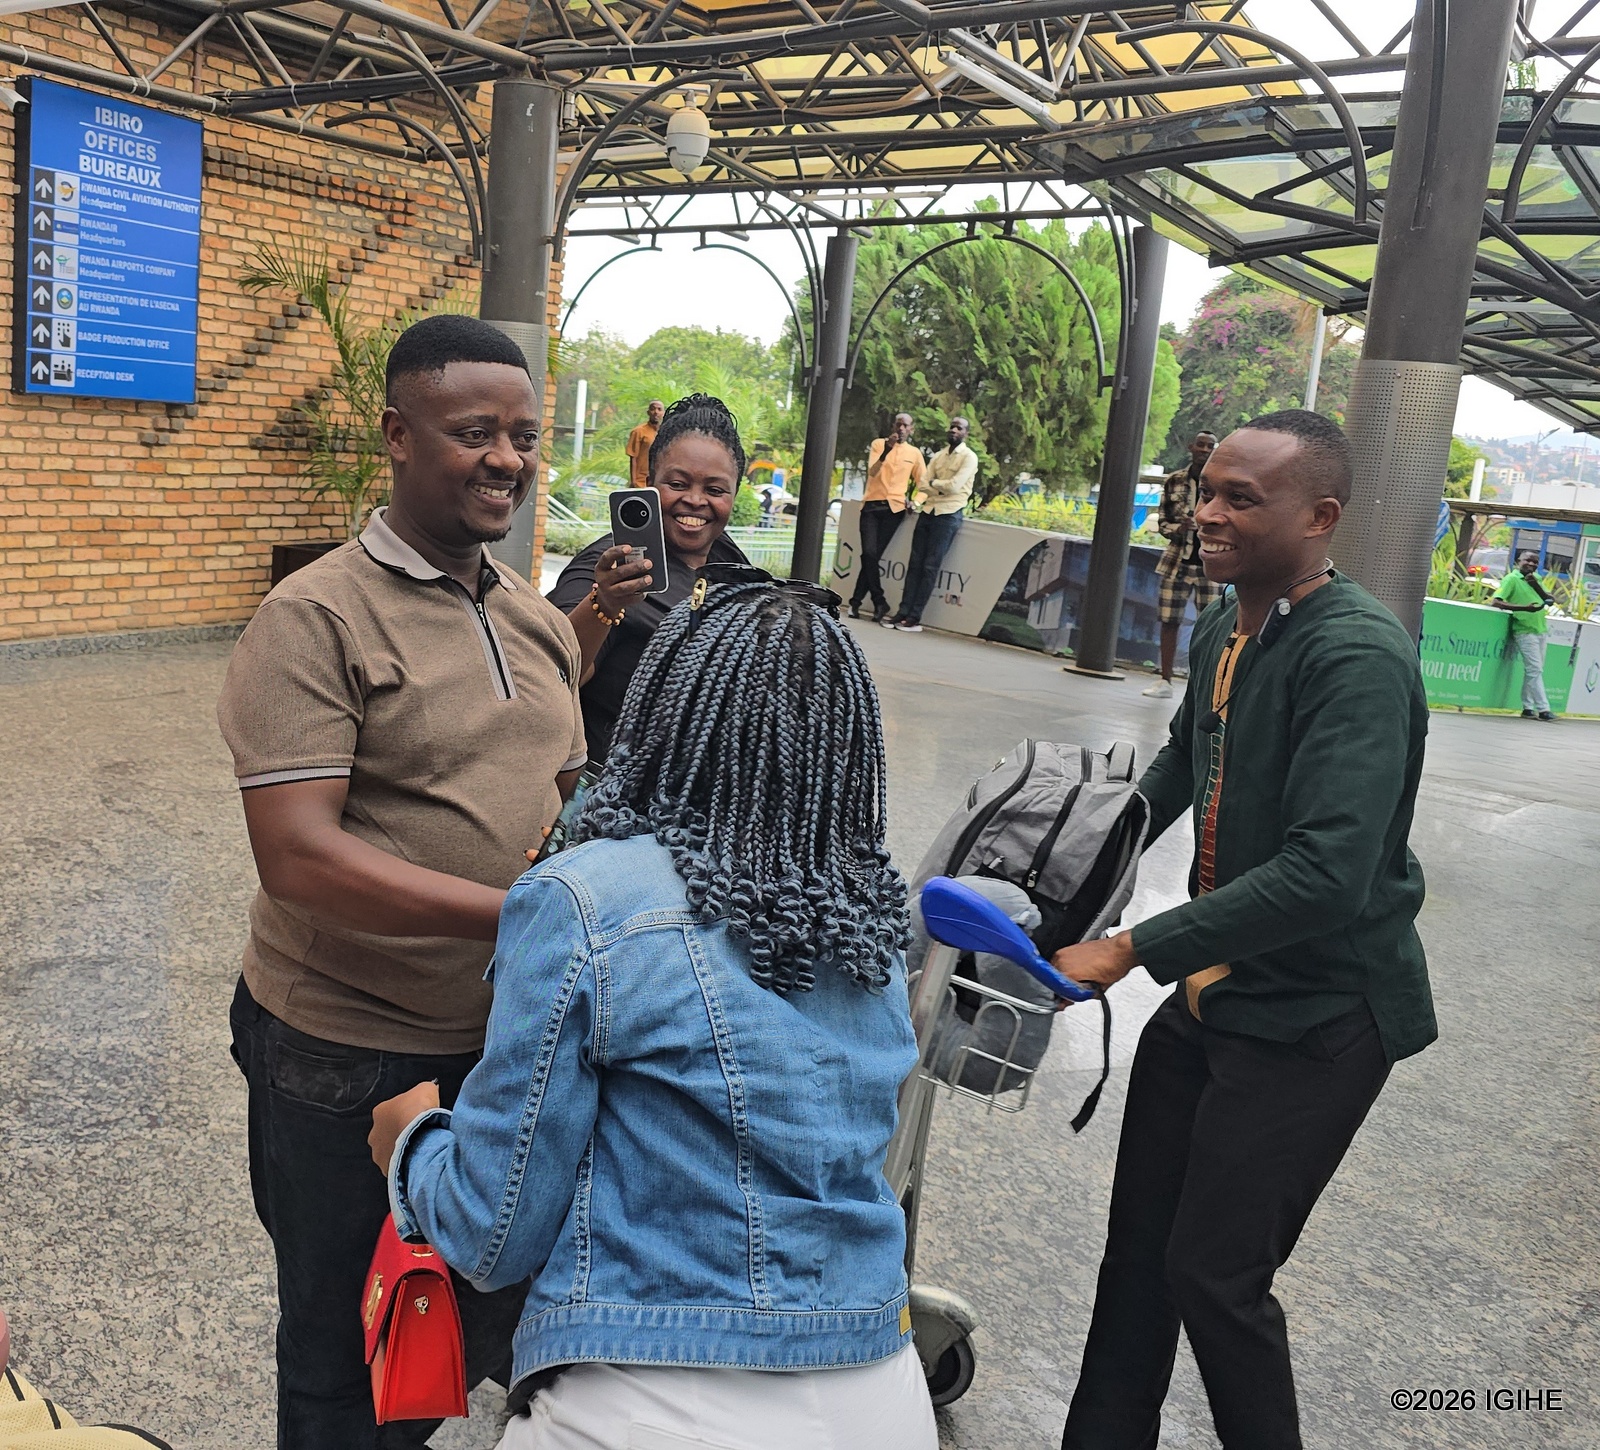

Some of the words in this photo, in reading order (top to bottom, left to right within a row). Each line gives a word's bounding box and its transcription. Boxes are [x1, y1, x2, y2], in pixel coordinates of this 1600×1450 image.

[95, 106, 143, 134] IBIRO
[84, 130, 157, 162] OFFICES
[79, 154, 162, 188] BUREAUX
[81, 182, 112, 197] RWANDA
[112, 189, 131, 201] CIVIL
[131, 193, 163, 207] AVIATION
[163, 200, 199, 215] AUTHORITY
[81, 195, 127, 212] Headquarters
[80, 218, 118, 233] RWANDAIR
[80, 230, 126, 247] Headquarters
[79, 254, 111, 267] RWANDA
[111, 259, 144, 273] AIRPORTS
[145, 264, 176, 278] COMPANY
[79, 266, 126, 282] Headquarters
[78, 302, 89, 312] AU
[90, 303, 120, 316] RWANDA
[79, 290, 139, 306] REPRESENTATION
[140, 298, 149, 308] DE
[150, 299, 180, 312] L'ASECNA
[78, 331, 102, 343] BADGE
[103, 334, 146, 347] PRODUCTION
[147, 339, 170, 350] OFFICE
[76, 368, 115, 380] RECEPTION
[116, 371, 135, 382] DESK
[937, 569, 971, 593] ITY
[1446, 660, 1483, 683] need
